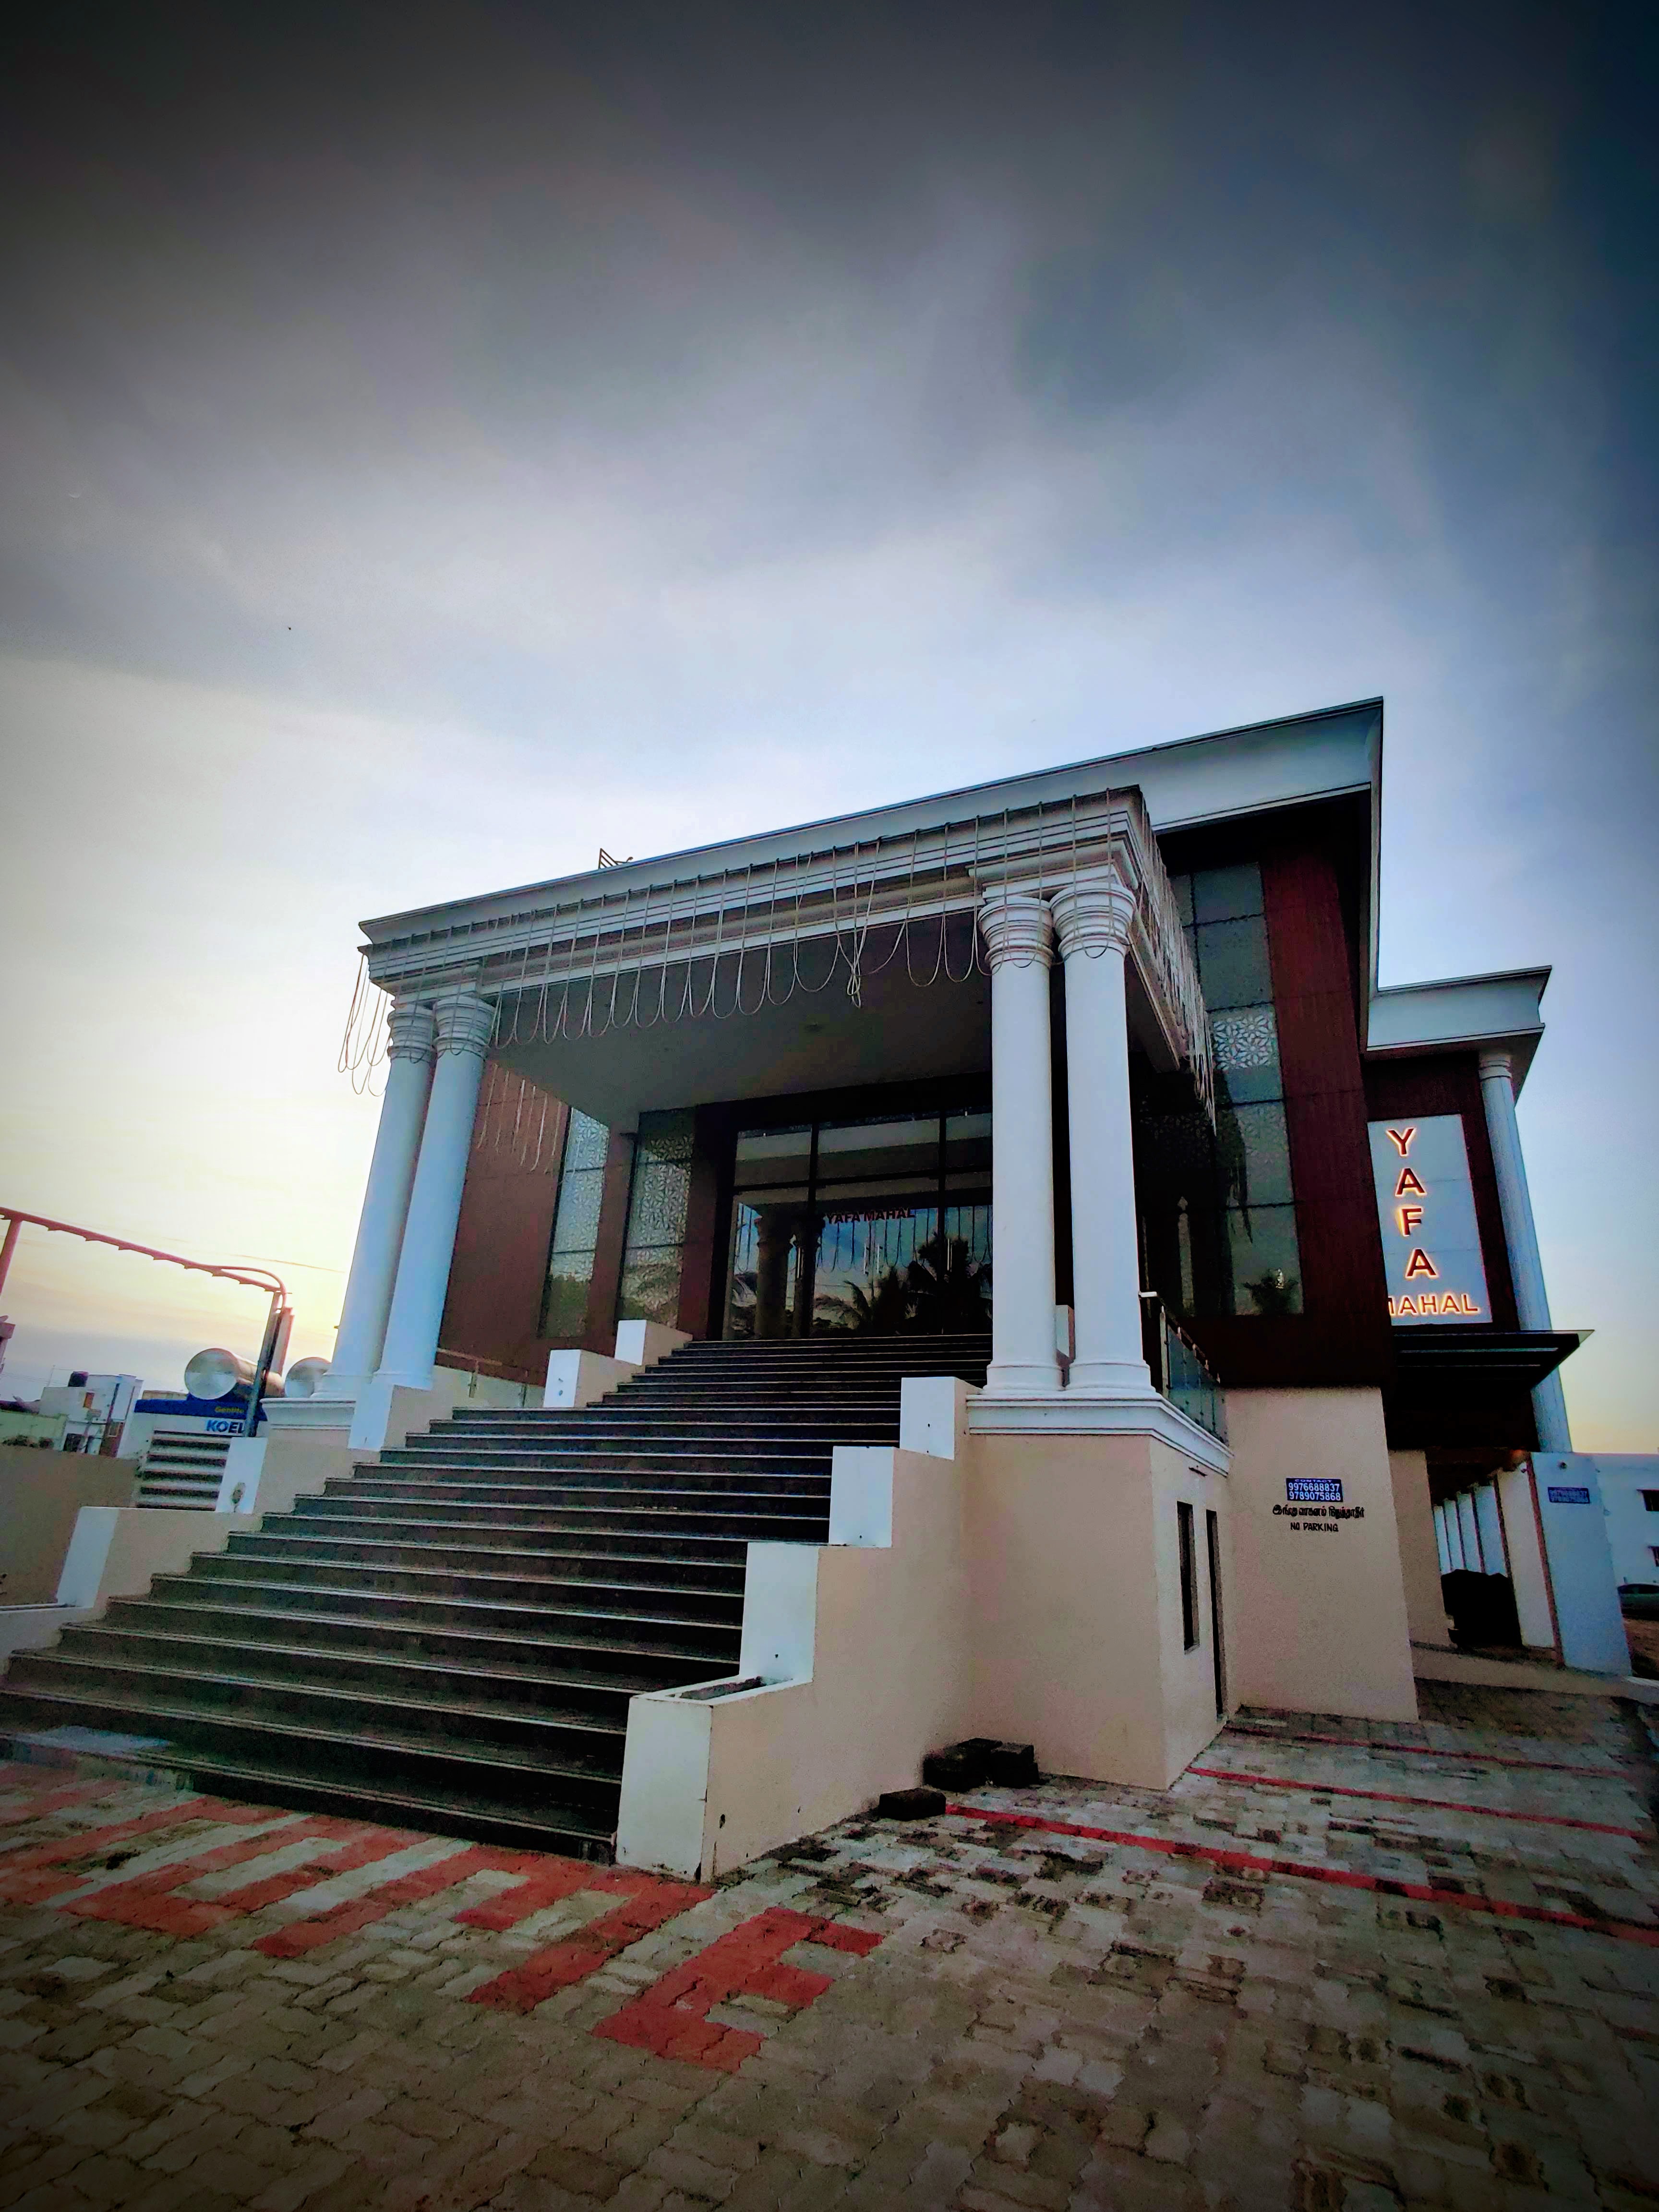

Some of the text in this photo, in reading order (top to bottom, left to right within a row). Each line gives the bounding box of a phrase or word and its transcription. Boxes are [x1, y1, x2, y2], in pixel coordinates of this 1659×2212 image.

[1387, 1128, 1436, 1277] YAFA
[827, 1206, 916, 1224] YAFA MAHAL
[1288, 1482, 1340, 1491] 9976688837
[1289, 1491, 1341, 1501] 9789075868
[1273, 1504, 1297, 1516] இங்கு
[1303, 1522, 1339, 1532] PARKING
